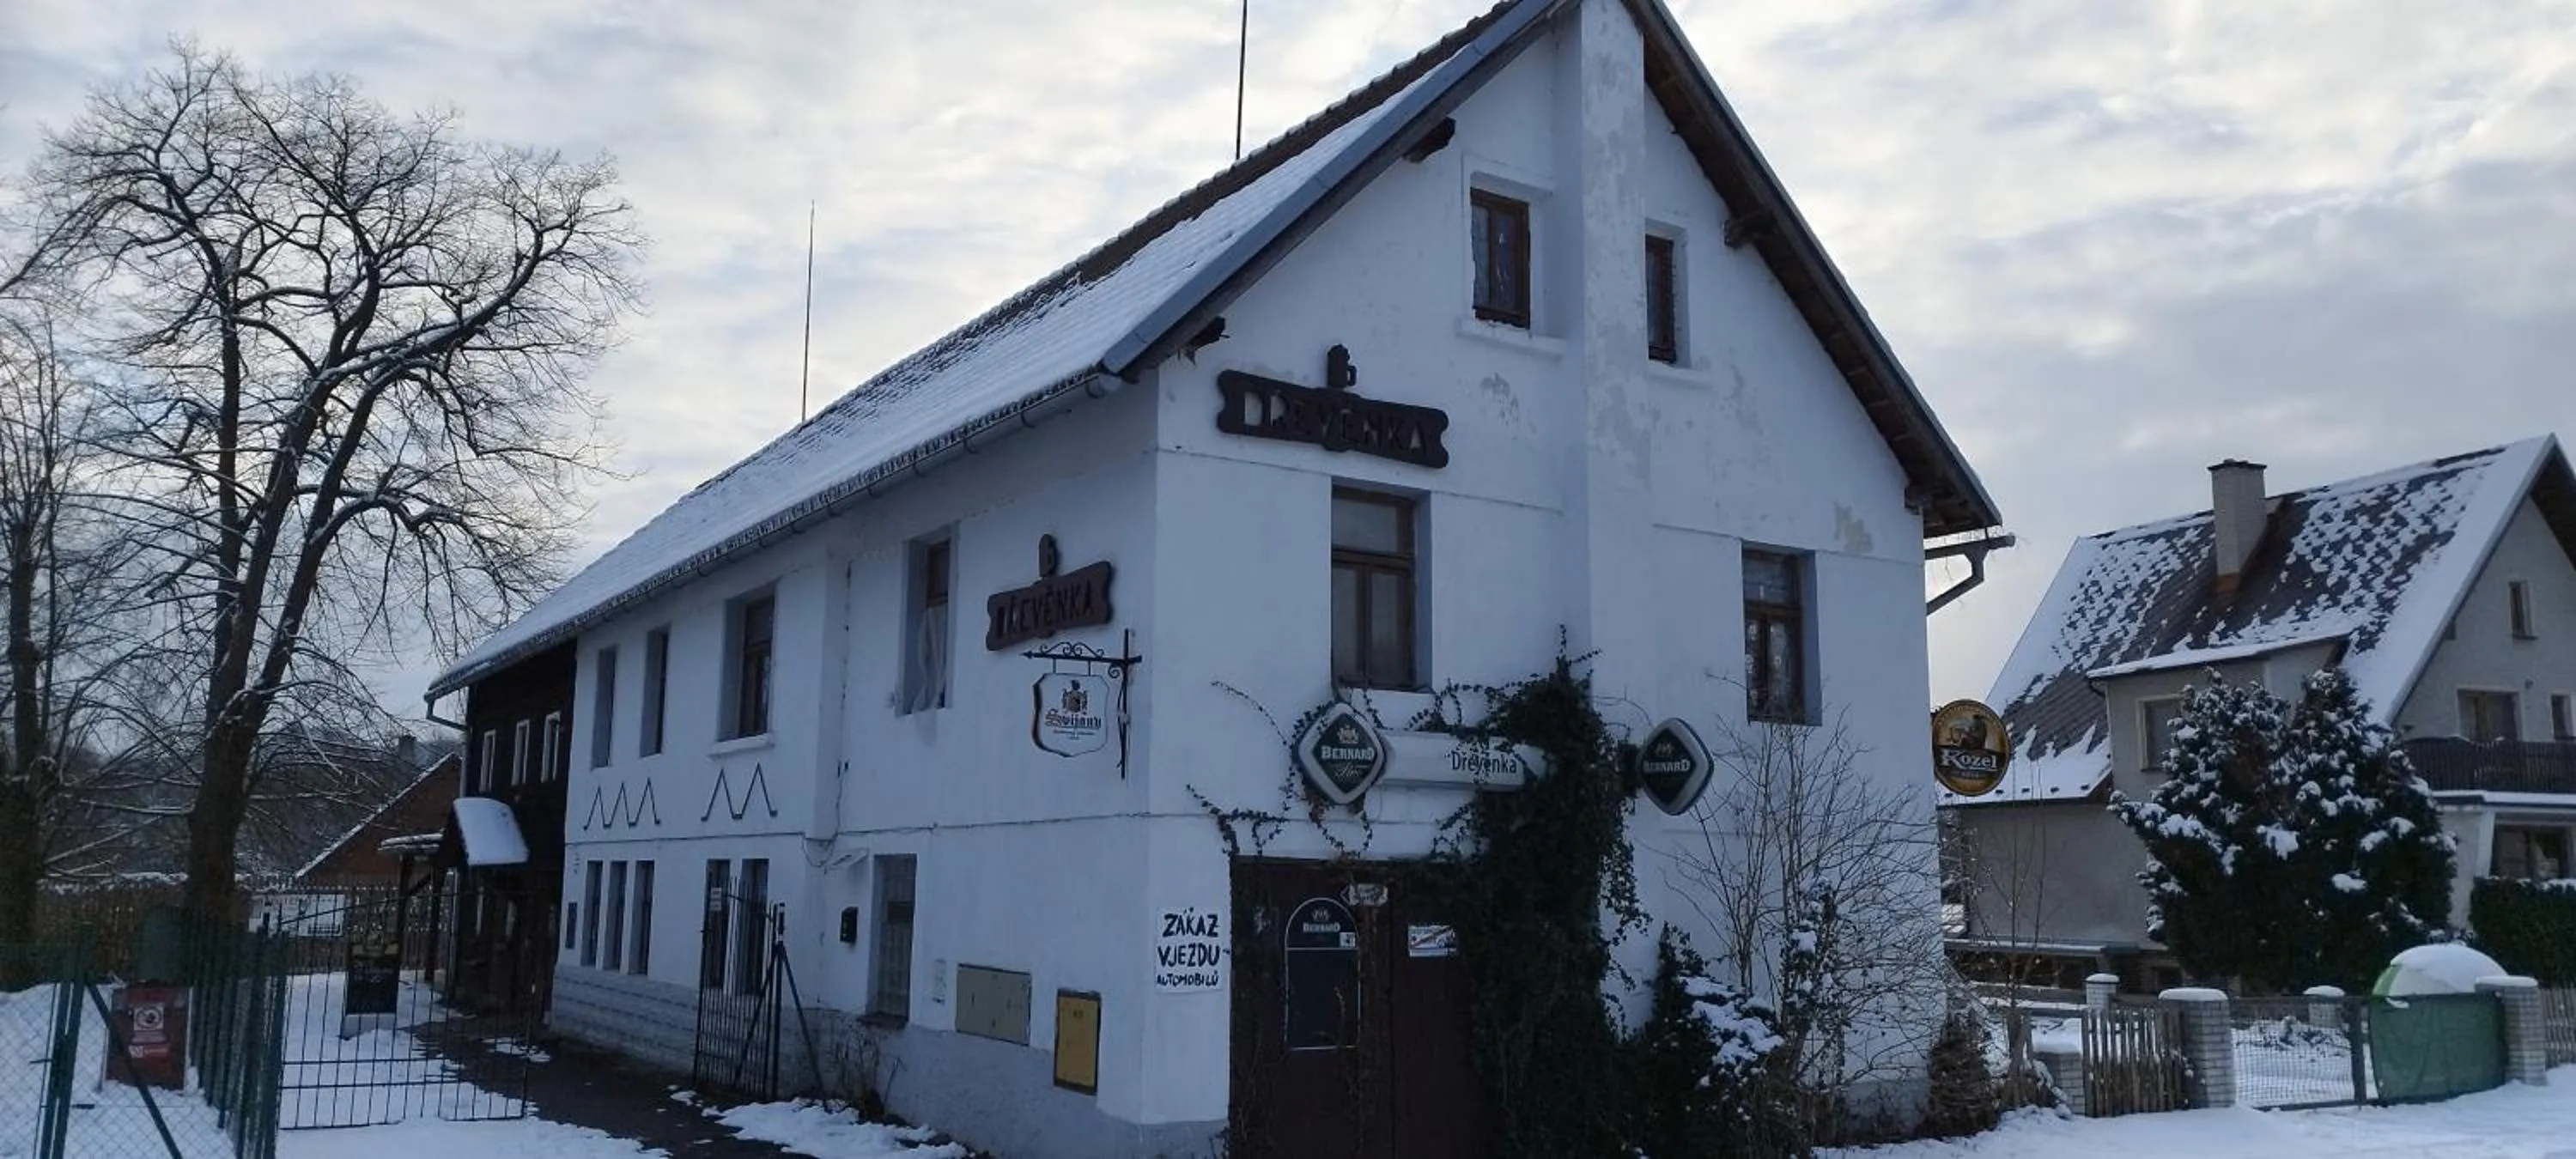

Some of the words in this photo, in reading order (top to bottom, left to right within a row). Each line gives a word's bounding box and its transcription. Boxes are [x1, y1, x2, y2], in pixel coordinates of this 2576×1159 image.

[1321, 744, 1376, 762] BERNARD
[1940, 749, 1997, 770] Kozel
[1642, 758, 1691, 774] BERNARD
[1162, 907, 1220, 938] ZÁKAZ
[1157, 943, 1220, 968] VJEZDU
[1156, 970, 1219, 986] AUTOMOBILŮ
